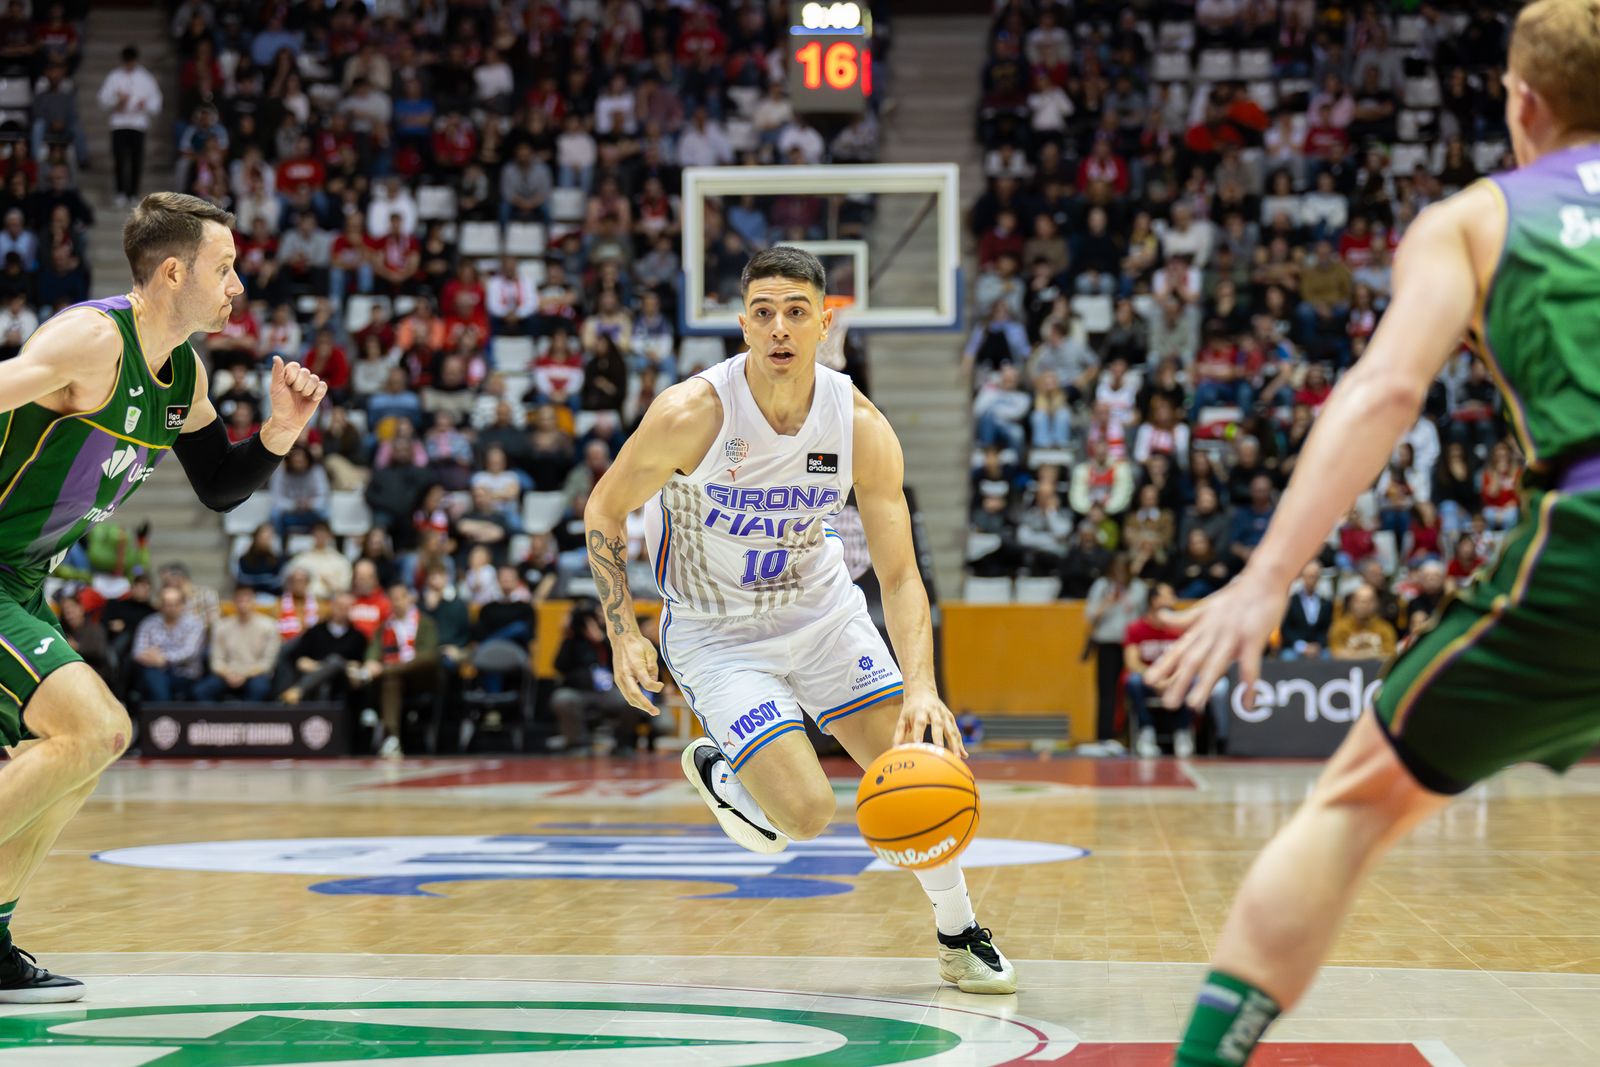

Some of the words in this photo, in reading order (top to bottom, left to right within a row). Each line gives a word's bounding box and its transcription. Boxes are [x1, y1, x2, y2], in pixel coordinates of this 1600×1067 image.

[795, 41, 859, 91] 16
[168, 412, 181, 421] liga
[704, 482, 841, 512] GIRONA
[740, 549, 791, 587] 10
[851, 681, 872, 691] Pirineu
[855, 674, 871, 683] Costa
[729, 700, 782, 741] YOSOY
[874, 835, 958, 866] Wilson
